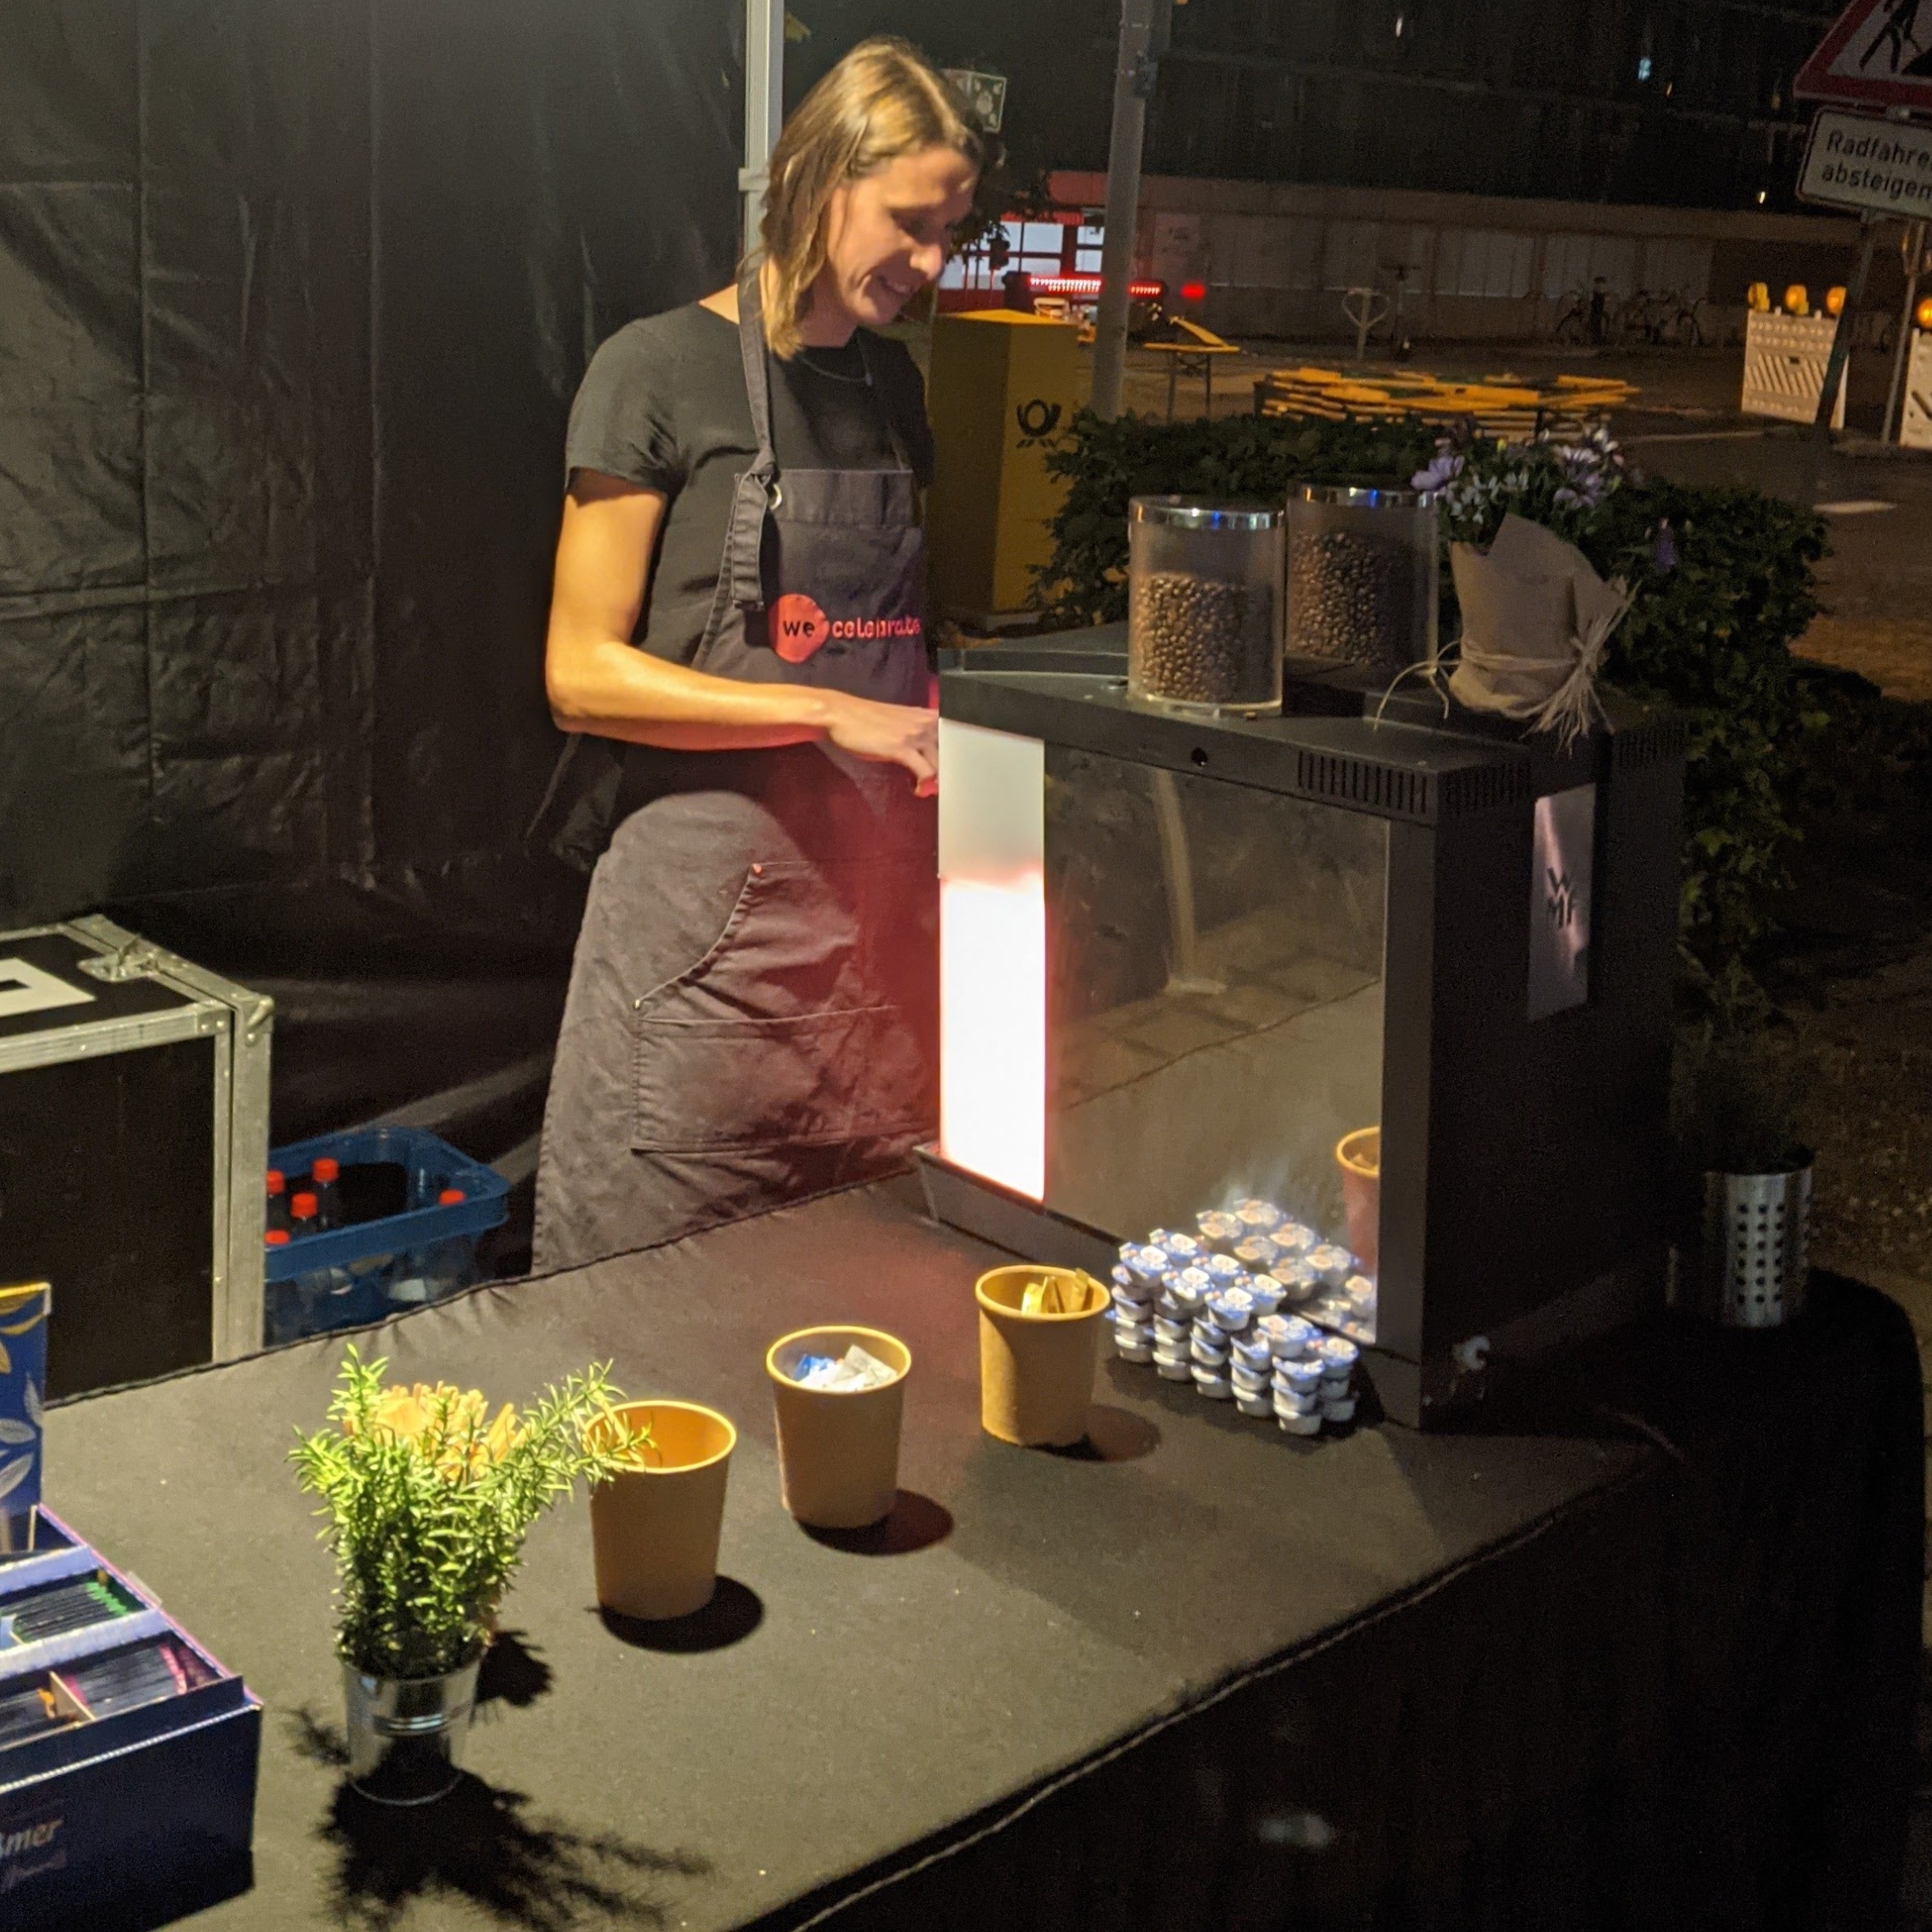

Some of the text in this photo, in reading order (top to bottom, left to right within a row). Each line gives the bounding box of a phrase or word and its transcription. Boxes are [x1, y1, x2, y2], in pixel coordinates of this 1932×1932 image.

[1826, 129, 1932, 170] Radfahre
[1821, 160, 1932, 201] absteigen
[783, 620, 816, 638] we
